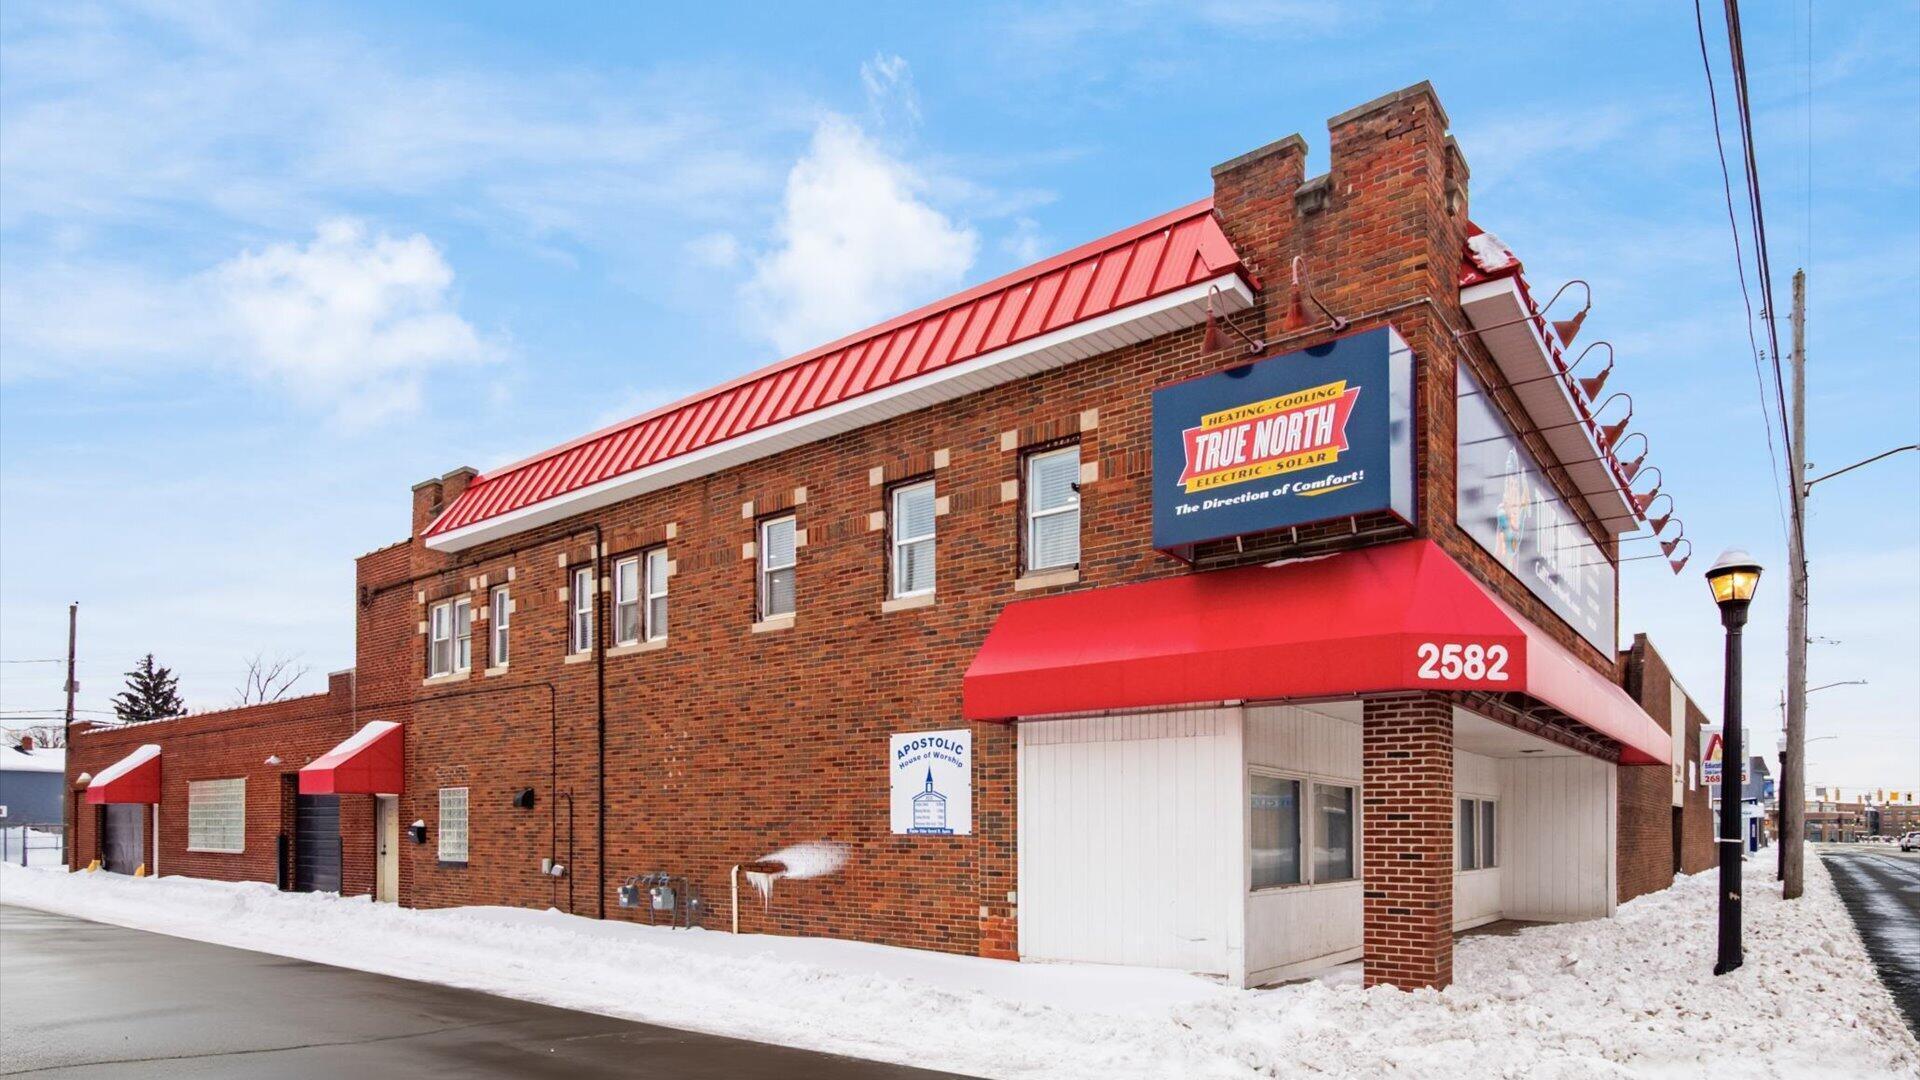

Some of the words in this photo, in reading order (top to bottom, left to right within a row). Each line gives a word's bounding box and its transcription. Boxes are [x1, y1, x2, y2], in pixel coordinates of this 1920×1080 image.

[1208, 405, 1265, 426] HEATING
[1275, 387, 1336, 410] COOLING
[1194, 424, 1251, 473] TRUE
[1252, 403, 1336, 460] NORTH
[1196, 466, 1261, 487] ELECTRIC
[1276, 452, 1327, 471] SOLAR
[1175, 503, 1199, 516] The
[1202, 486, 1269, 511] Direction
[1272, 484, 1290, 497] of
[1292, 470, 1364, 493] Comfort!
[1417, 642, 1509, 681] 2582
[897, 737, 964, 760] APOSTOLIC
[899, 755, 921, 769] House
[933, 751, 963, 768] Worship
